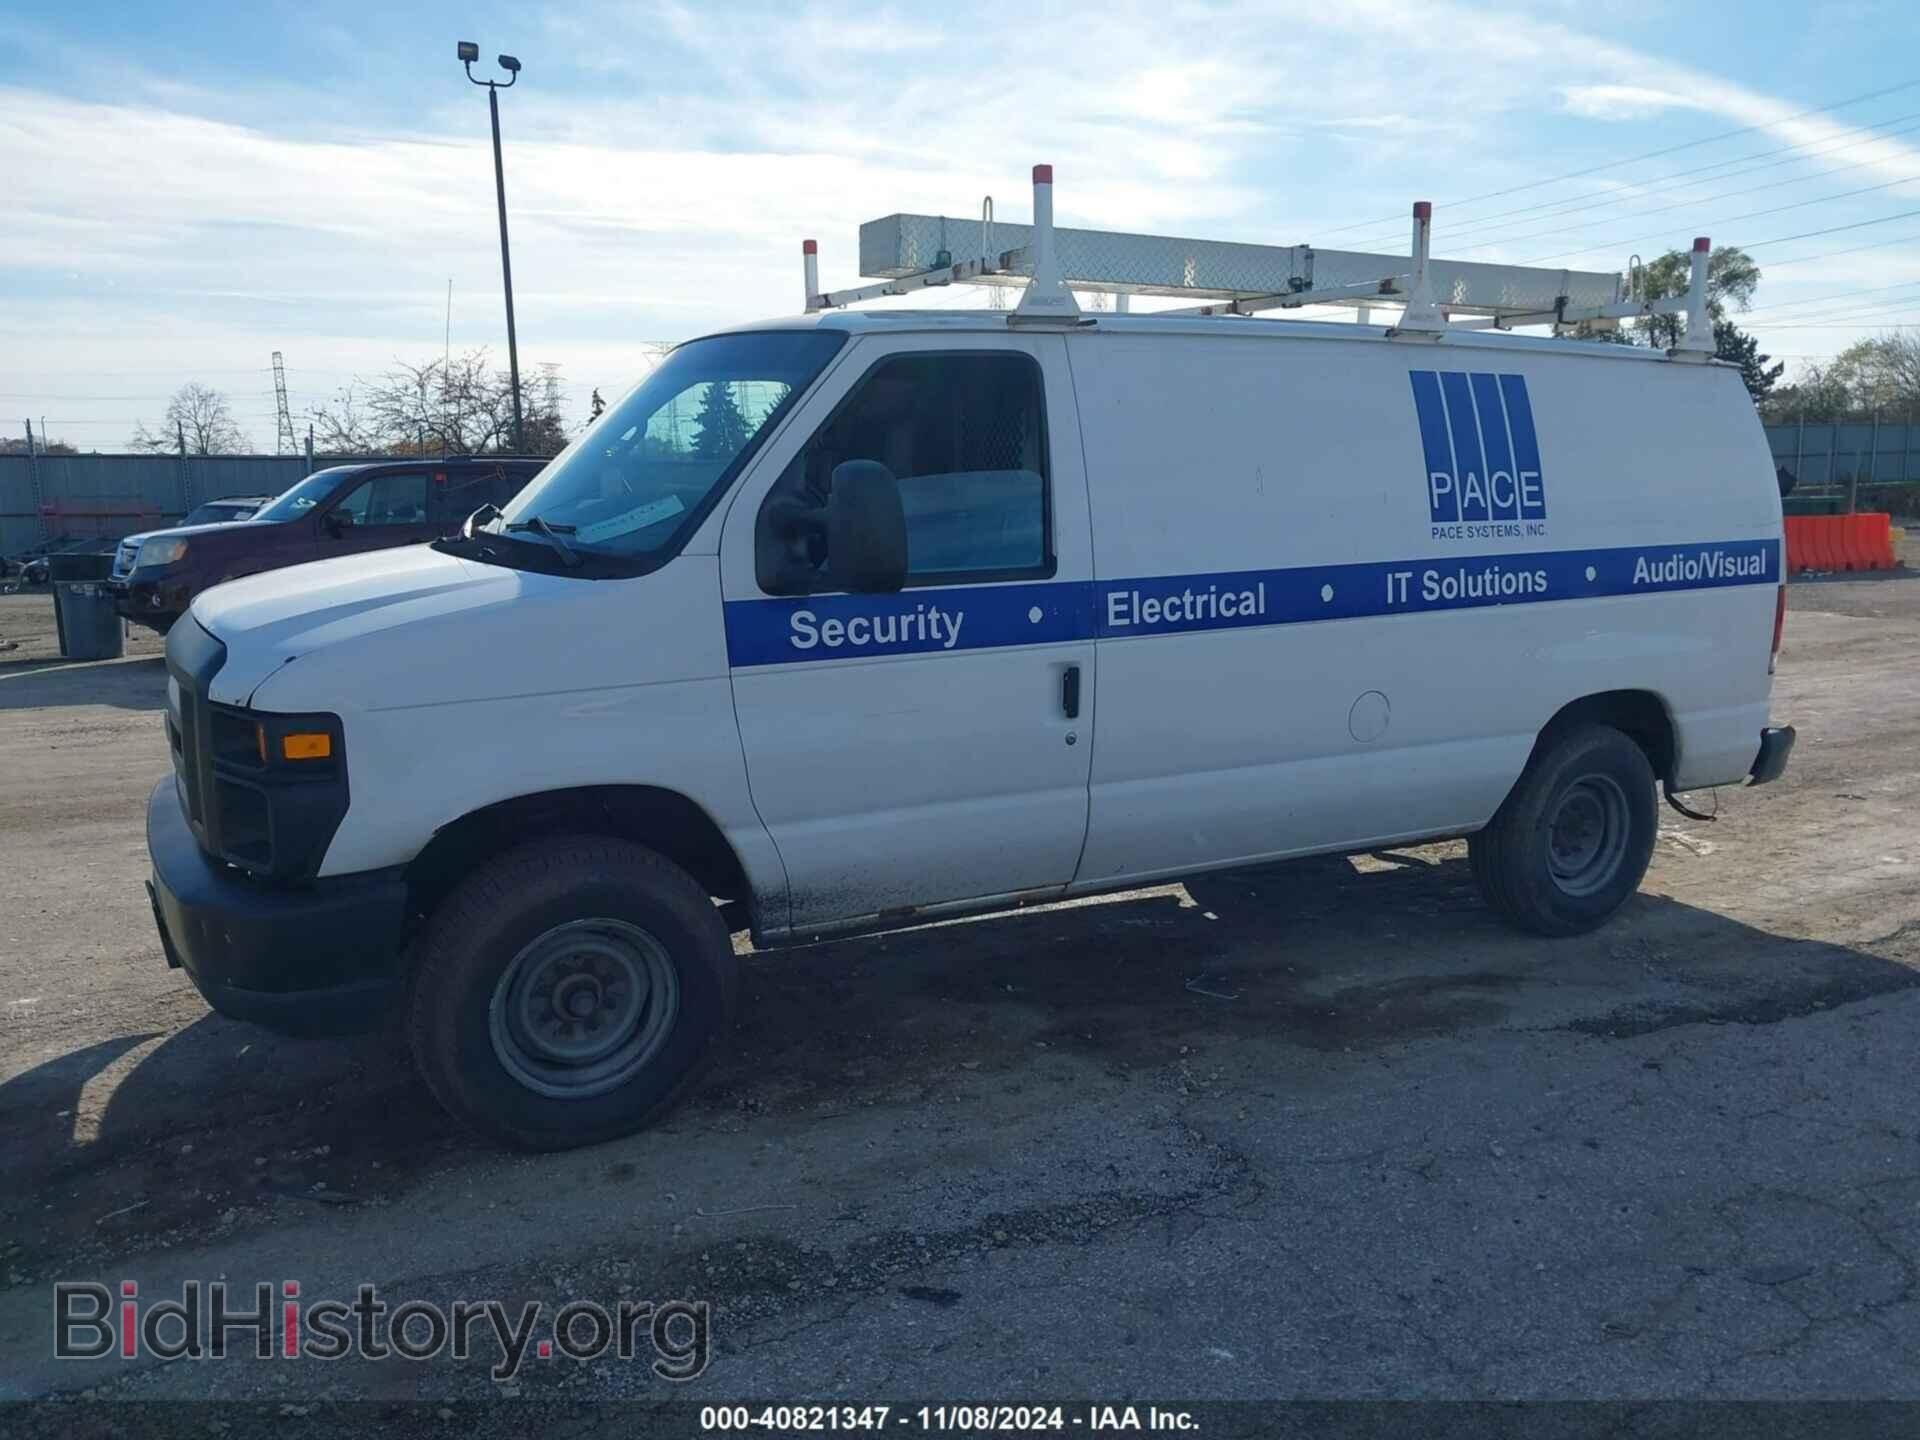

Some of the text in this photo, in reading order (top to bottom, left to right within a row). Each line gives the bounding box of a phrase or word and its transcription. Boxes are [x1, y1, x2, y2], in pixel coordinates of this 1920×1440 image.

[1430, 471, 1542, 508] PACE
[1431, 523, 1548, 539] PACE SYSTEMS, INC.
[789, 547, 1767, 649] Security Electrical IT Solutions Audio/Visual
